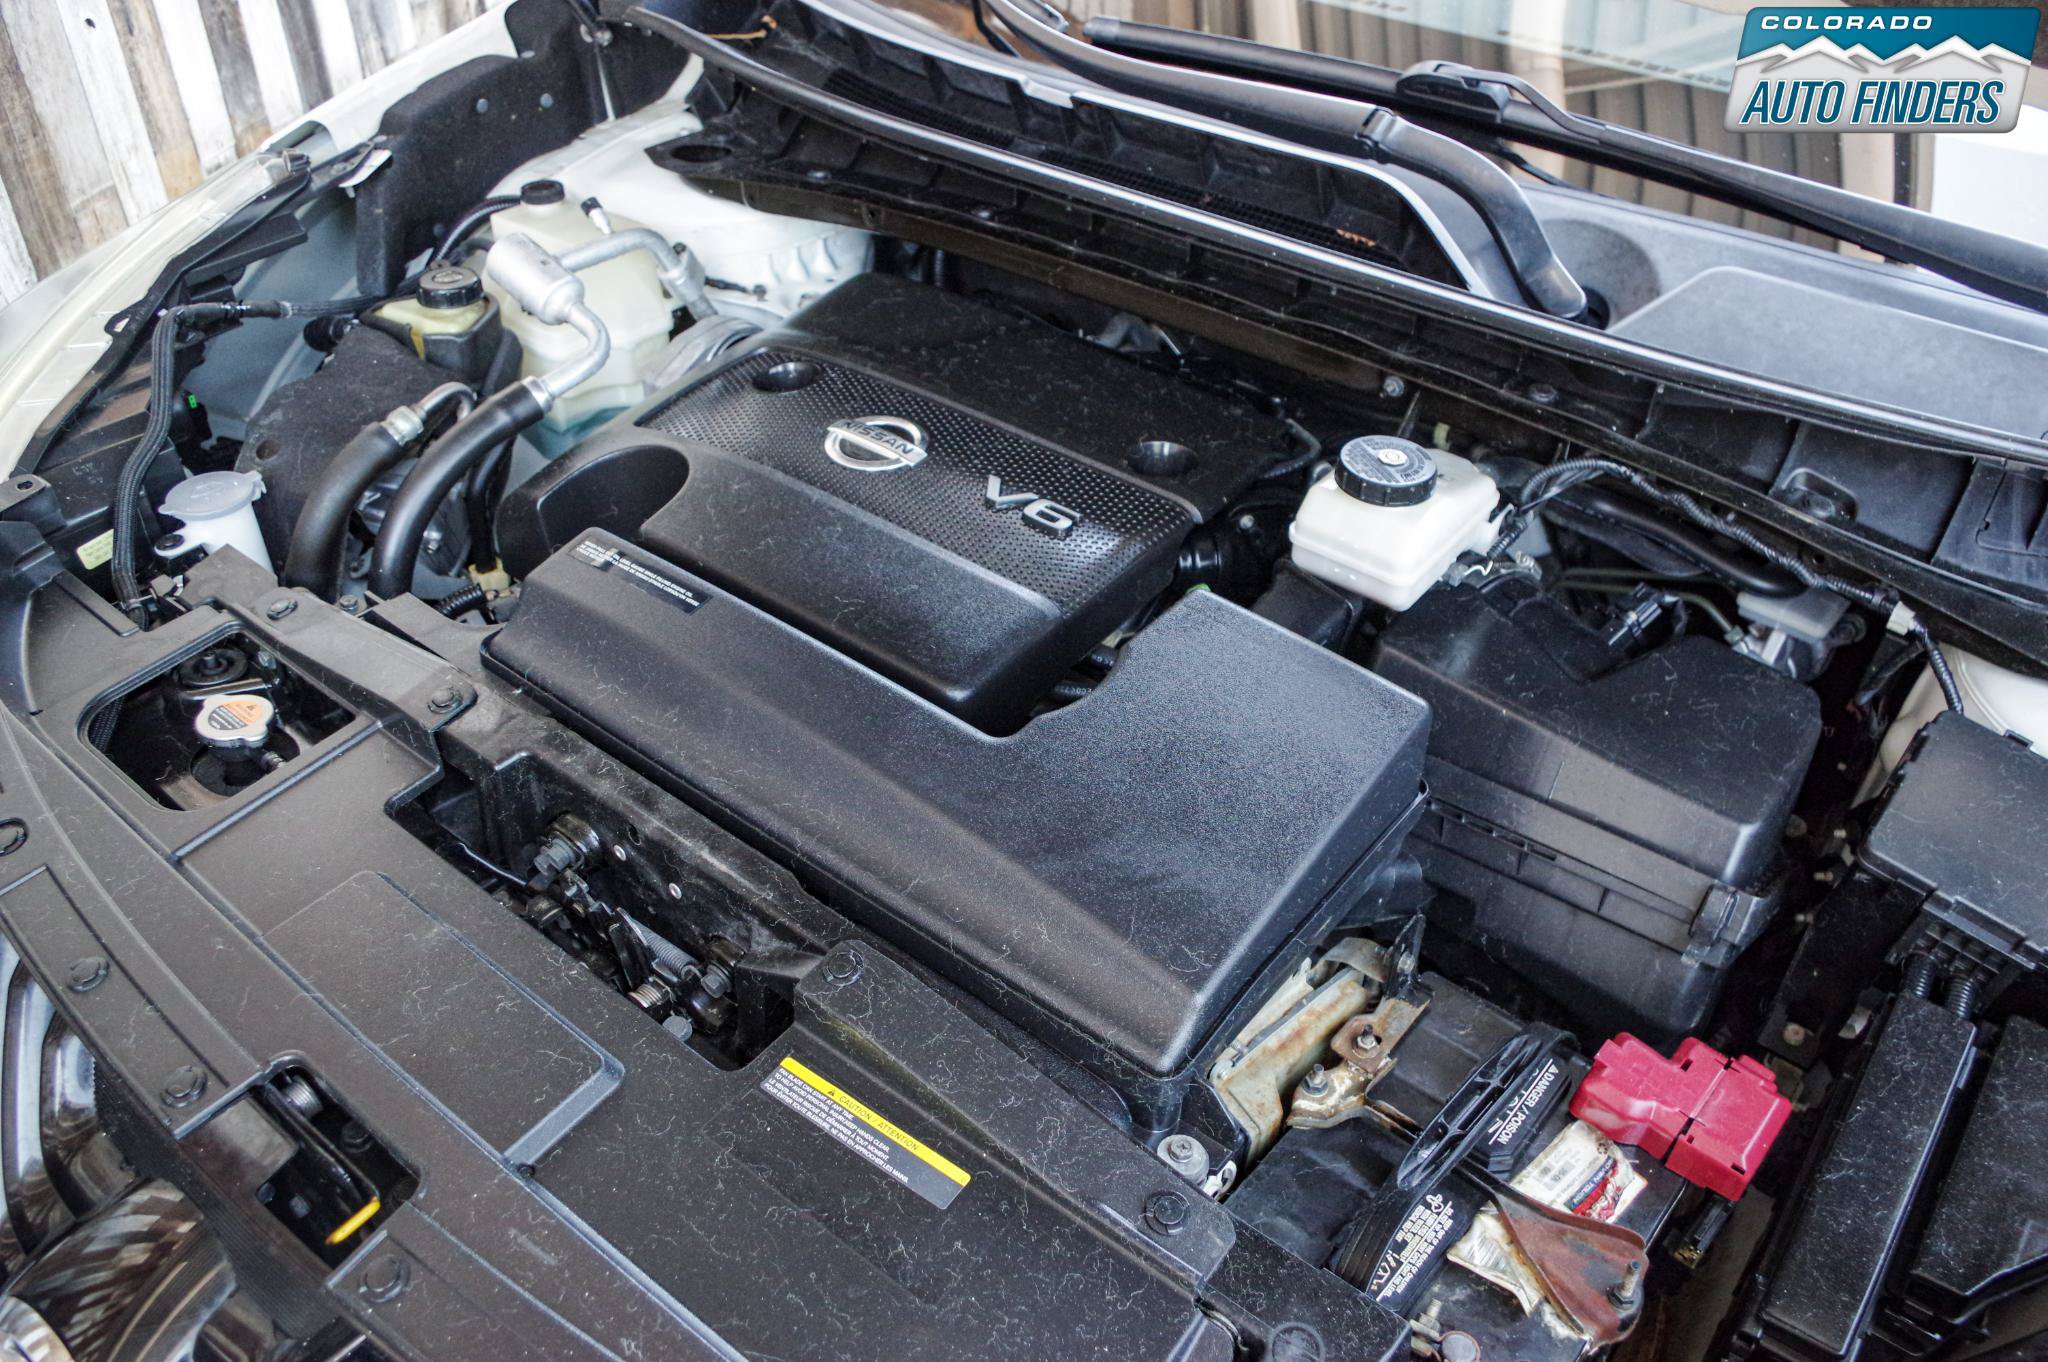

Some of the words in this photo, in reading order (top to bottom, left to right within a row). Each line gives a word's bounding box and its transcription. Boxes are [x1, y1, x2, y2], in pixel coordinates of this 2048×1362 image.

[841, 420, 915, 455] NISSAN
[985, 474, 1083, 538] V6
[763, 1082, 778, 1094] POUR
[801, 1083, 813, 1092] CAN
[811, 1090, 827, 1101] START
[1523, 1071, 1555, 1108] DANGER
[780, 1077, 794, 1088] HELP
[791, 1085, 807, 1096] AVOID
[805, 1094, 830, 1112] PERSONAL
[855, 1127, 874, 1141] HANDS
[837, 1095, 873, 1120] CAUTION
[876, 1120, 919, 1151] ATTENTION
[854, 1135, 868, 1146] TOUT
[1496, 1110, 1526, 1145] POISON
